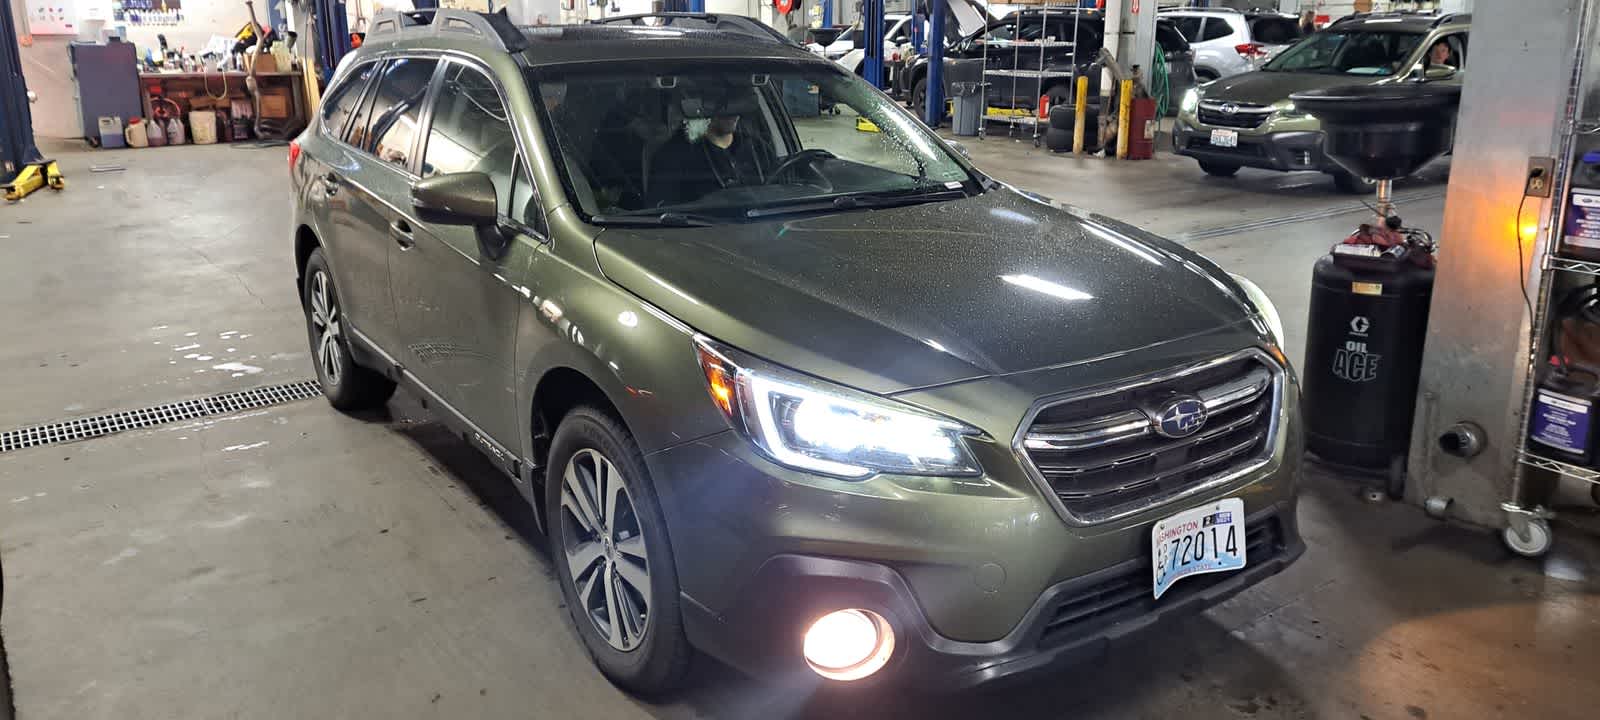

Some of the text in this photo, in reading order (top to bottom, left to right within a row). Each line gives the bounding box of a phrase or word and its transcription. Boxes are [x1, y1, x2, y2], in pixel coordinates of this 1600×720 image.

[1345, 340, 1368, 353] OIL
[1332, 349, 1383, 382] ACE
[1171, 525, 1238, 571] 72014
